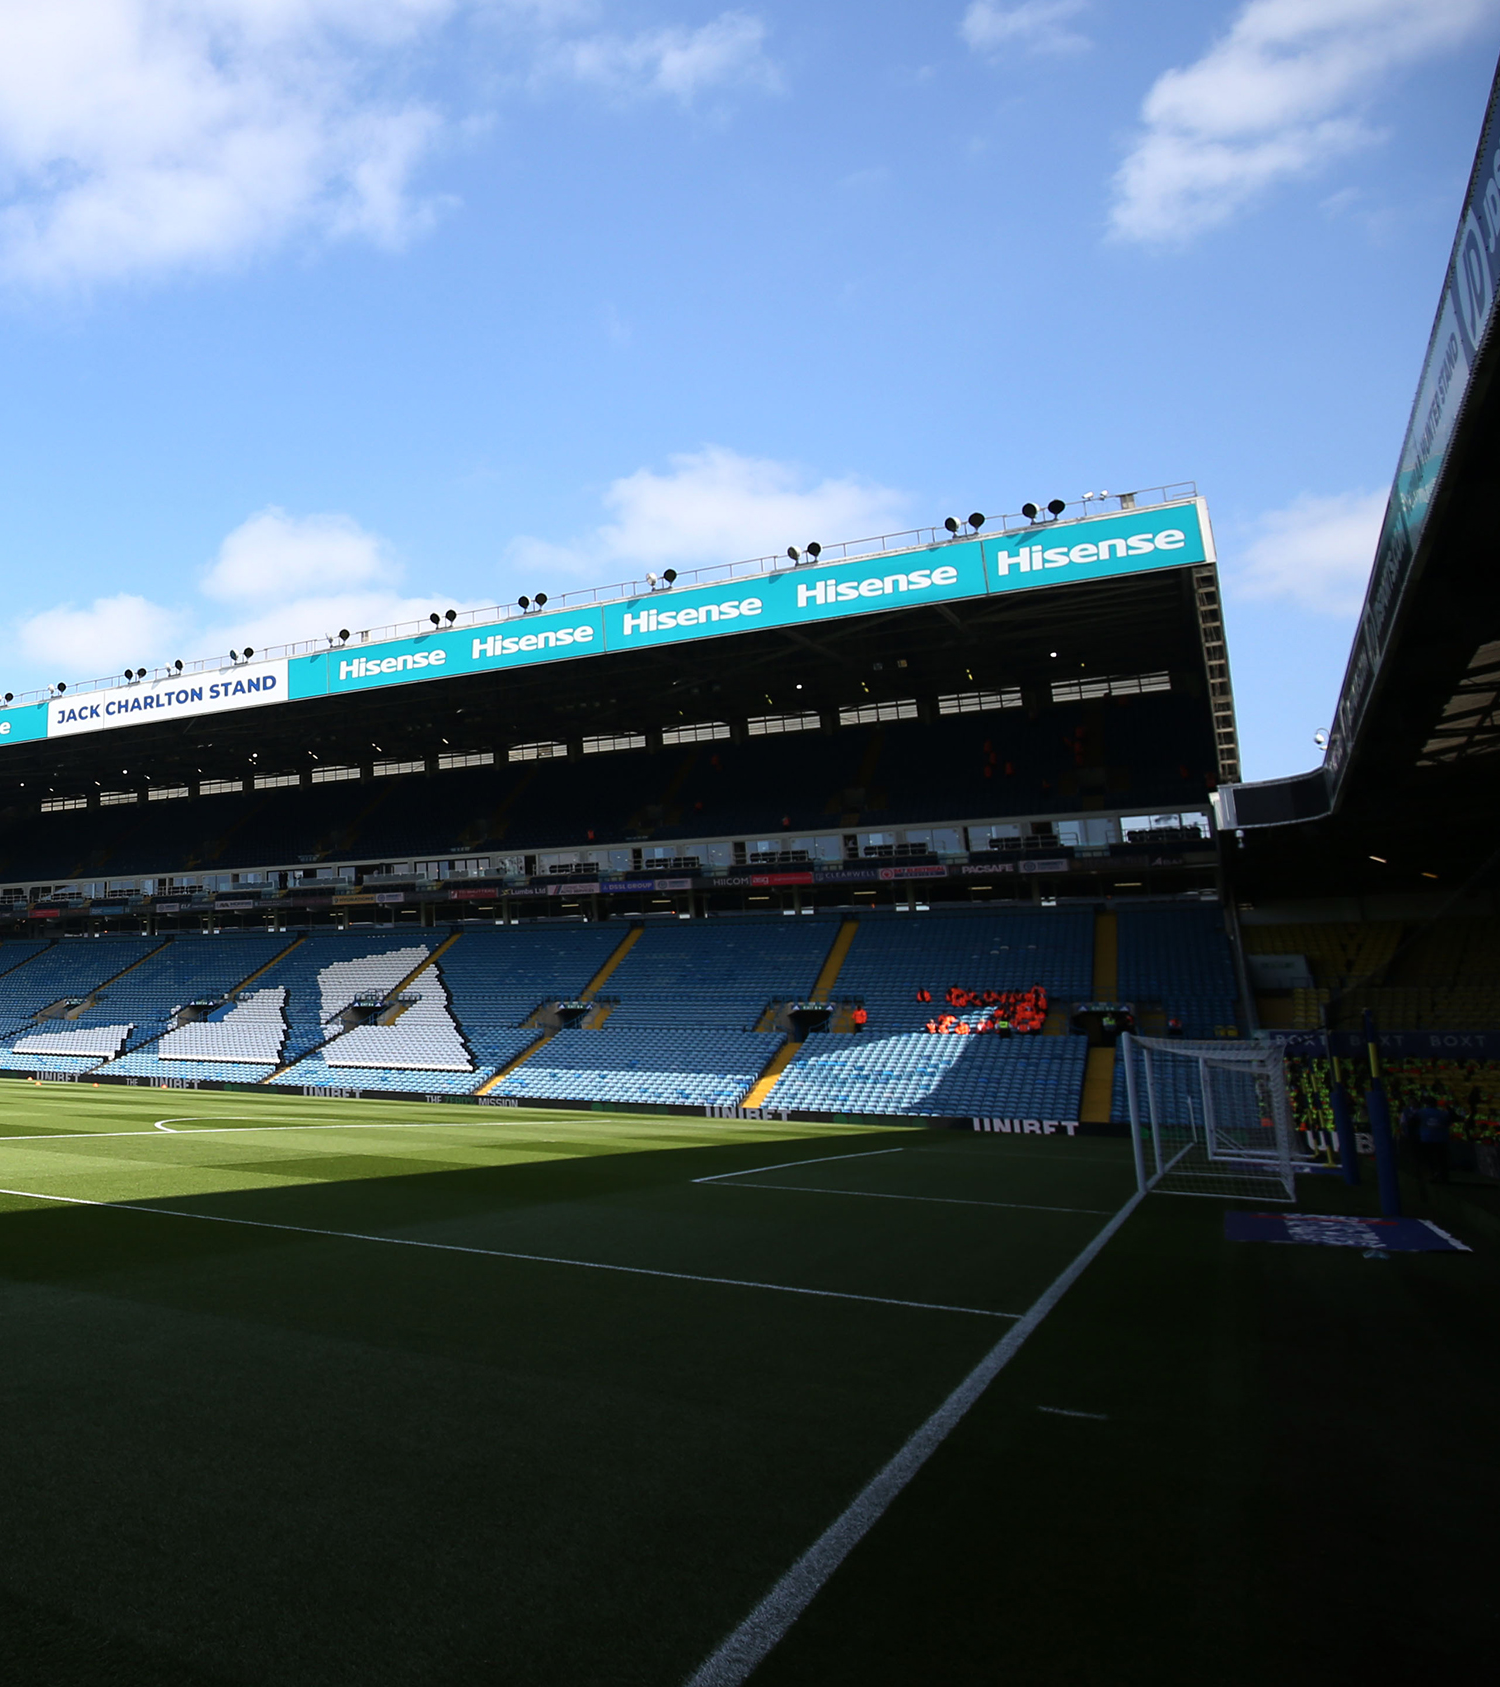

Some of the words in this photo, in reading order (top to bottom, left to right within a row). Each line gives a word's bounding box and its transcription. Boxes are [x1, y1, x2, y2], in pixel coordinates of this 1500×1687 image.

[1438, 332, 1459, 405] STAND
[997, 529, 1185, 577] Hisense
[797, 565, 959, 608] Hisense
[623, 597, 763, 636] Hisense
[471, 625, 595, 660] Hisense
[339, 649, 447, 681] Hisense
[57, 703, 101, 725] JACK
[105, 686, 204, 716] CHARLTON
[209, 675, 278, 700] STAND
[962, 864, 1013, 874] PACSAFE
[1349, 1035, 1405, 1046] BXT
[1429, 1035, 1486, 1047] BOXT
[126, 1078, 139, 1087] THE
[425, 1095, 442, 1104] THE
[478, 1097, 519, 1108] MISSION
